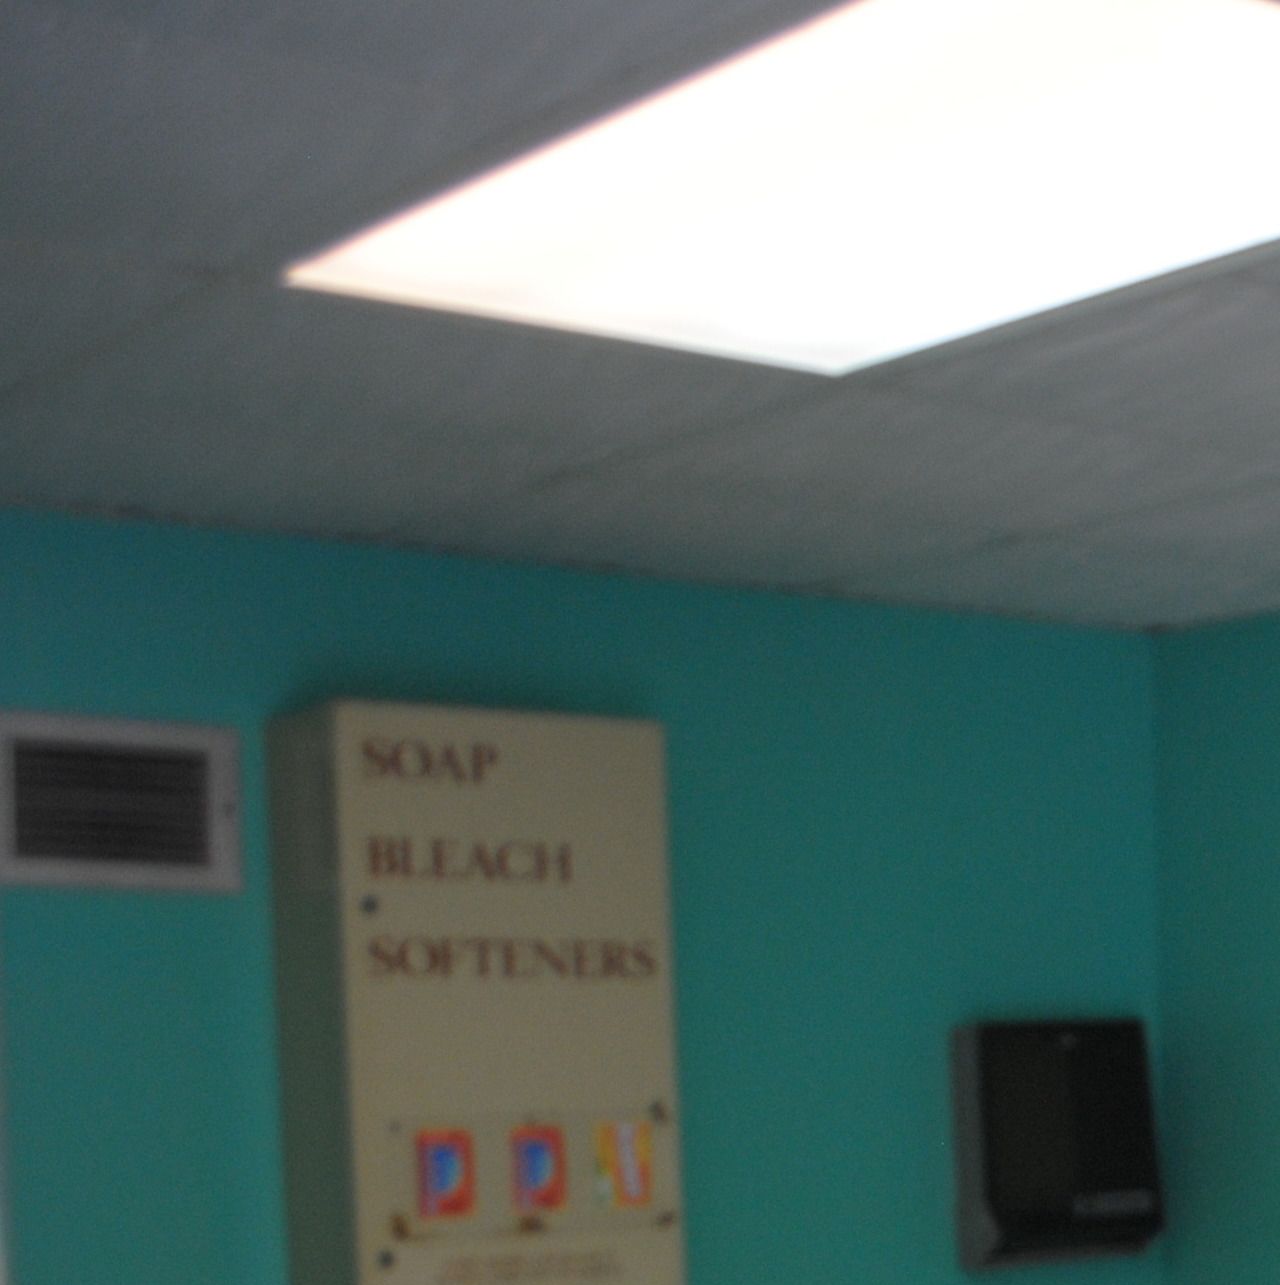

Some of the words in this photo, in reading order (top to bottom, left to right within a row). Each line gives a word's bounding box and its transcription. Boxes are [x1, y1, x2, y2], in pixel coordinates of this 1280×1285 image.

[362, 739, 498, 783] SOAP
[367, 834, 573, 883] BLEACH
[368, 934, 659, 981] SOFTENERS
